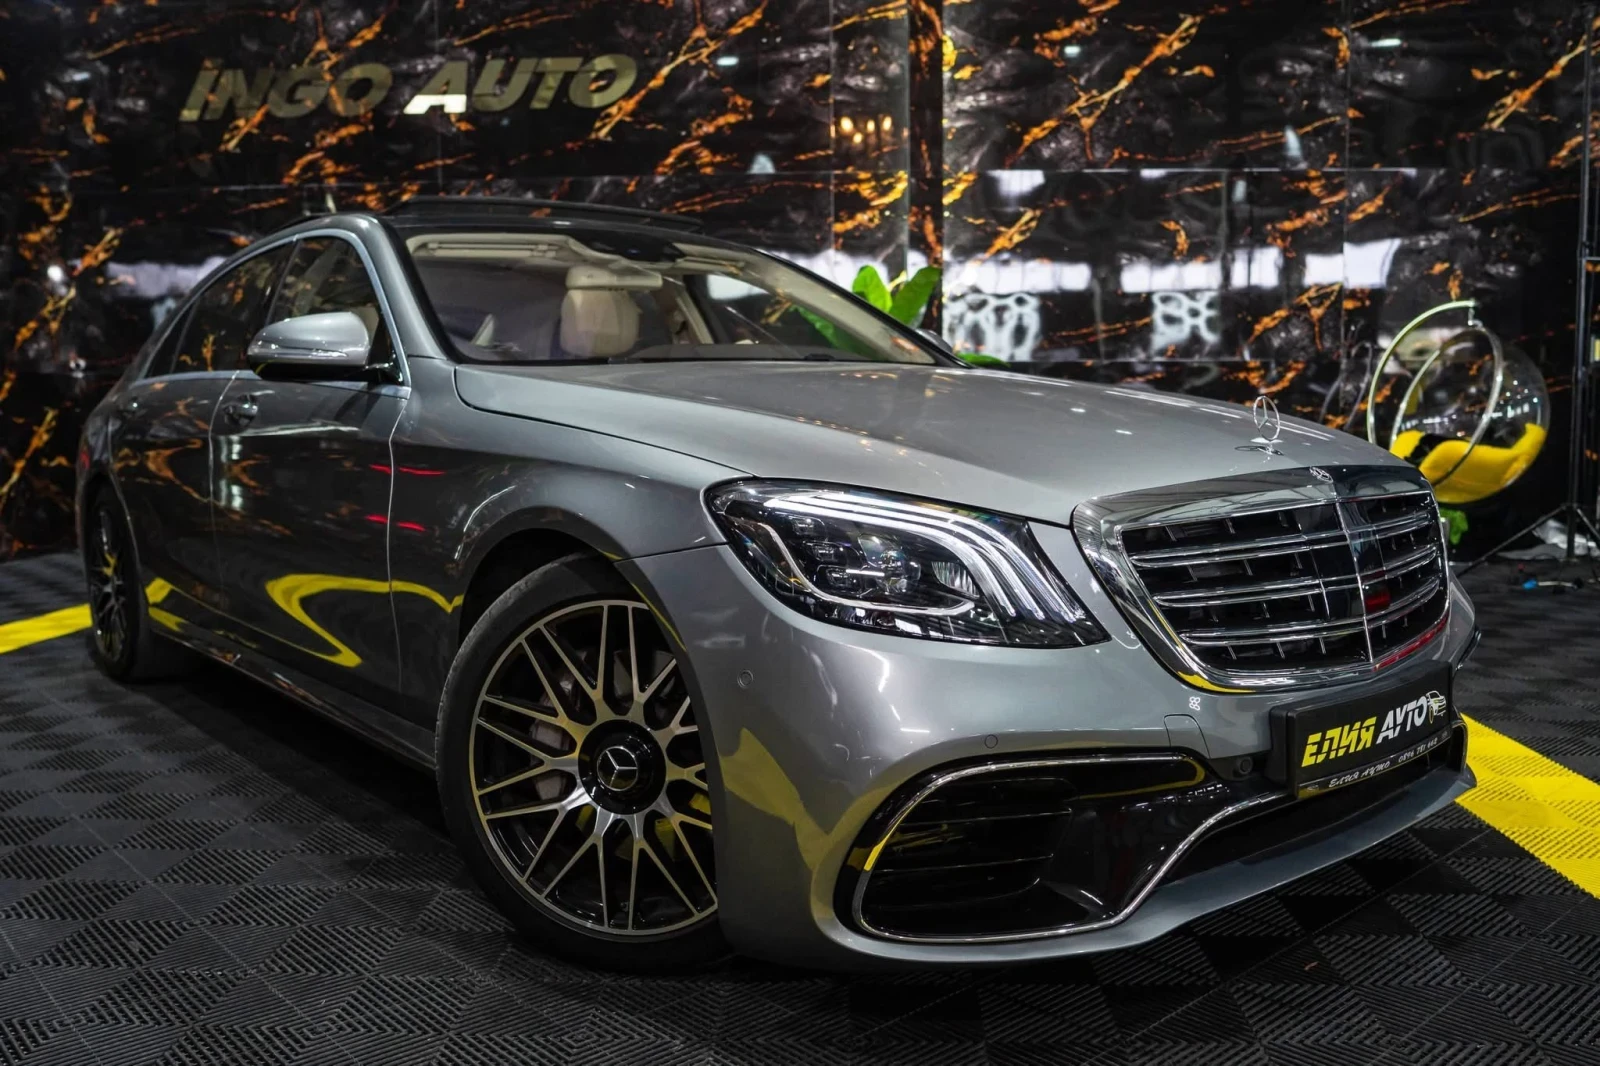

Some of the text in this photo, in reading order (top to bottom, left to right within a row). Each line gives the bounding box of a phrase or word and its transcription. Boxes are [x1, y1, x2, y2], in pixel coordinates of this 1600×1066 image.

[179, 53, 638, 122] INGO AUTO
[1301, 716, 1377, 768] ЕЛИЯ
